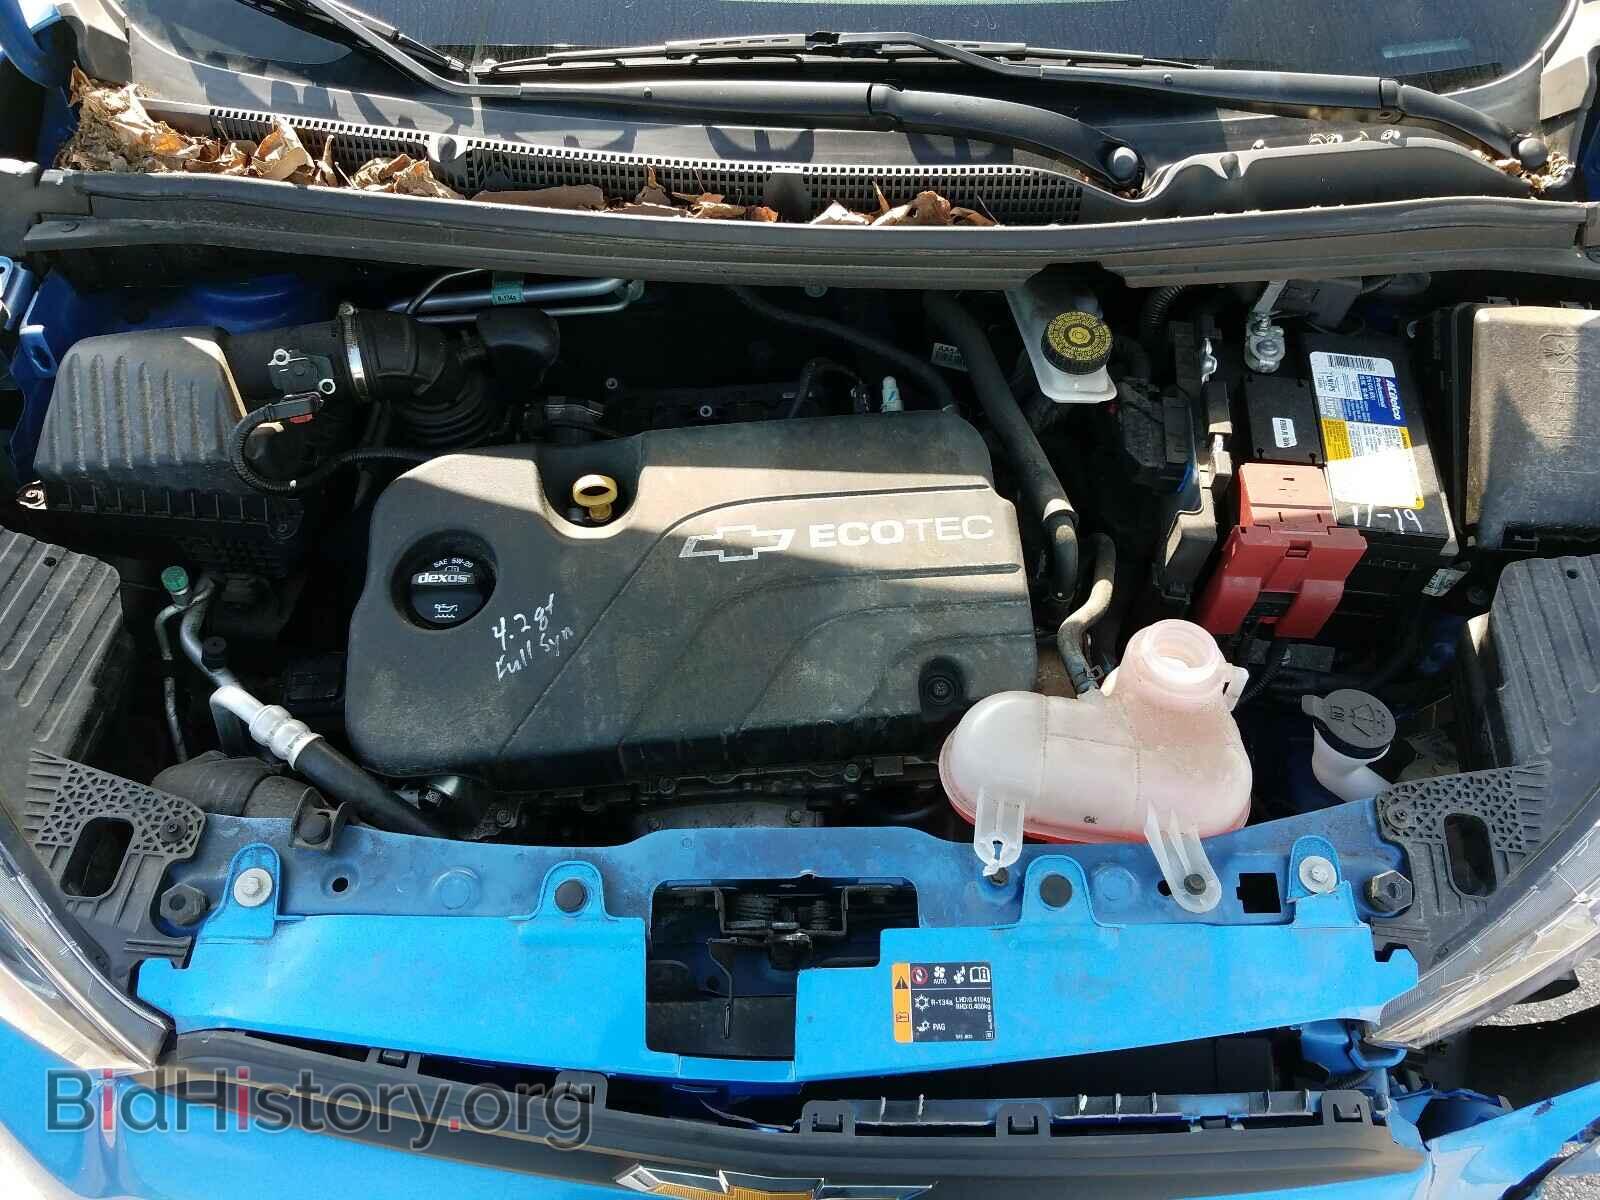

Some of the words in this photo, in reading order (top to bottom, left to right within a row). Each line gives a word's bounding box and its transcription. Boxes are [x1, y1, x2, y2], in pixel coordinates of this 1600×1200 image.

[1386, 379, 1401, 421] ACDelco
[810, 514, 993, 548] ECOTEC
[433, 558, 448, 568] SAE
[495, 640, 533, 682] Full
[539, 626, 575, 657] Syn
[930, 998, 954, 1007] R-134a
[932, 1023, 946, 1031] PAG
